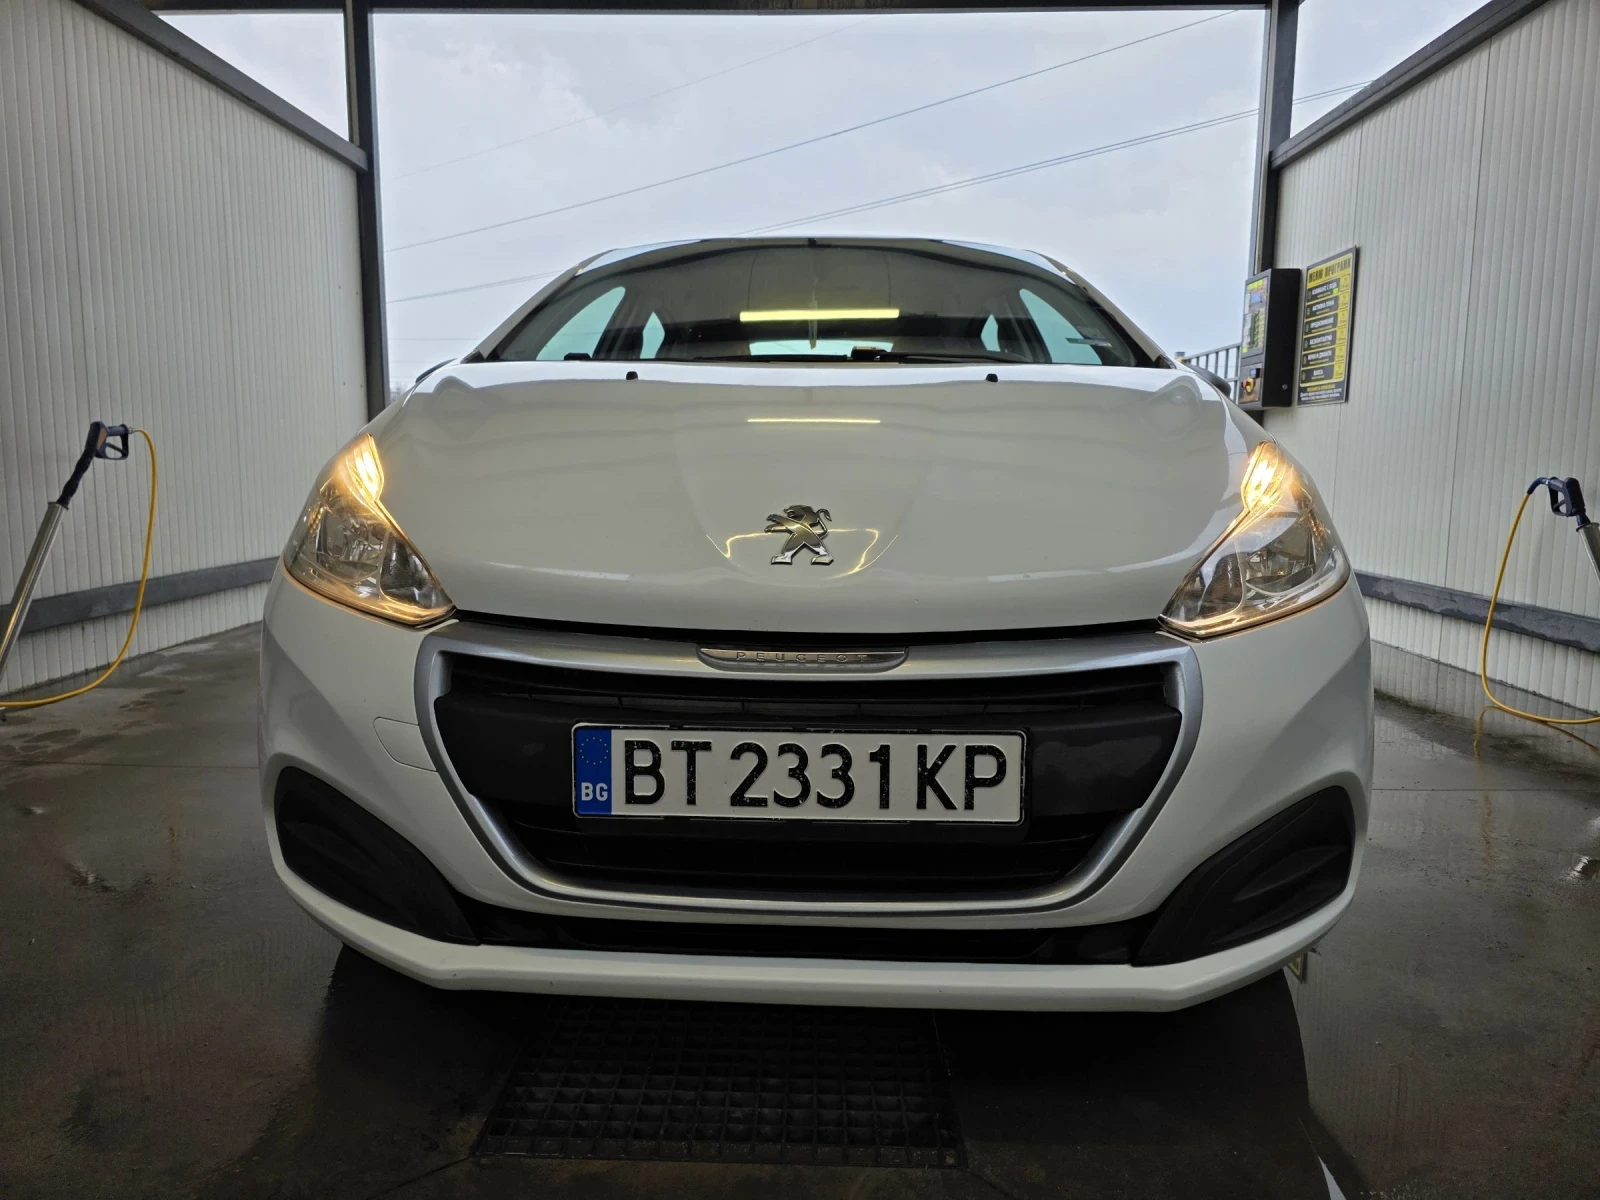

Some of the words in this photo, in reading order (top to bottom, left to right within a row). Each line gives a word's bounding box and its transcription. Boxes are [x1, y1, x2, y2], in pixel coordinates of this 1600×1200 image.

[736, 652, 868, 663] PEUGEOT
[624, 739, 712, 805] BT
[730, 742, 891, 809] 2331
[916, 744, 1007, 810] KP
[581, 782, 608, 801] BG
